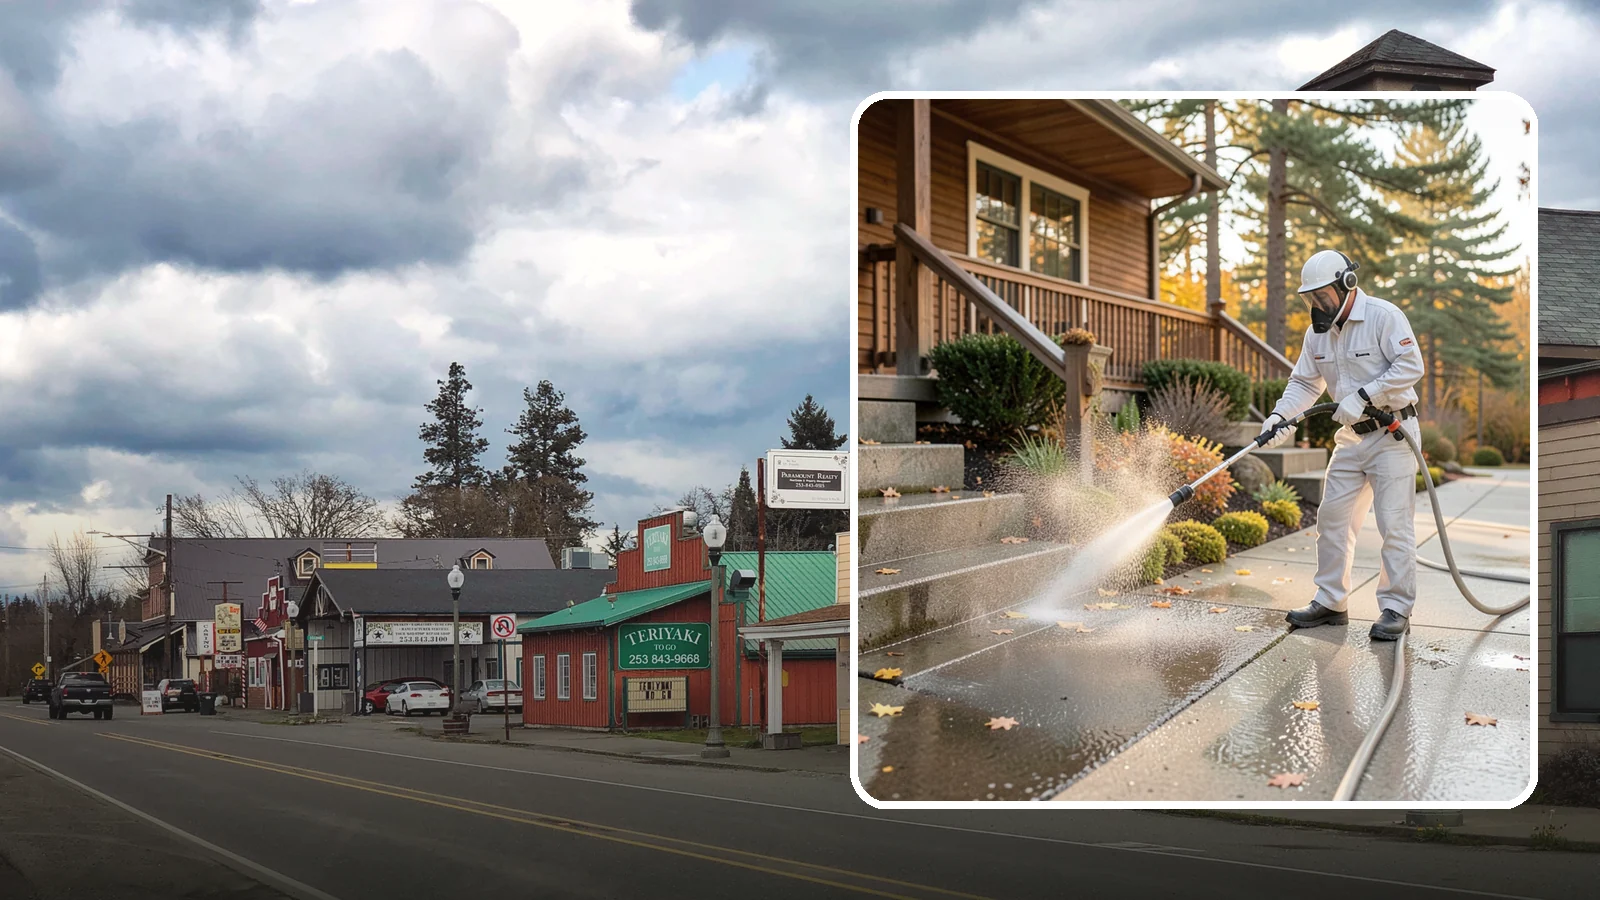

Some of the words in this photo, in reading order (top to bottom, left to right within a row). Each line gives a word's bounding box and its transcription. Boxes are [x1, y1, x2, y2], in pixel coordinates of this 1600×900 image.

[625, 627, 702, 646] TERIYAKI
[629, 654, 648, 665] 253
[651, 653, 700, 664] 843-9668
[639, 681, 672, 690] TERIYAKI
